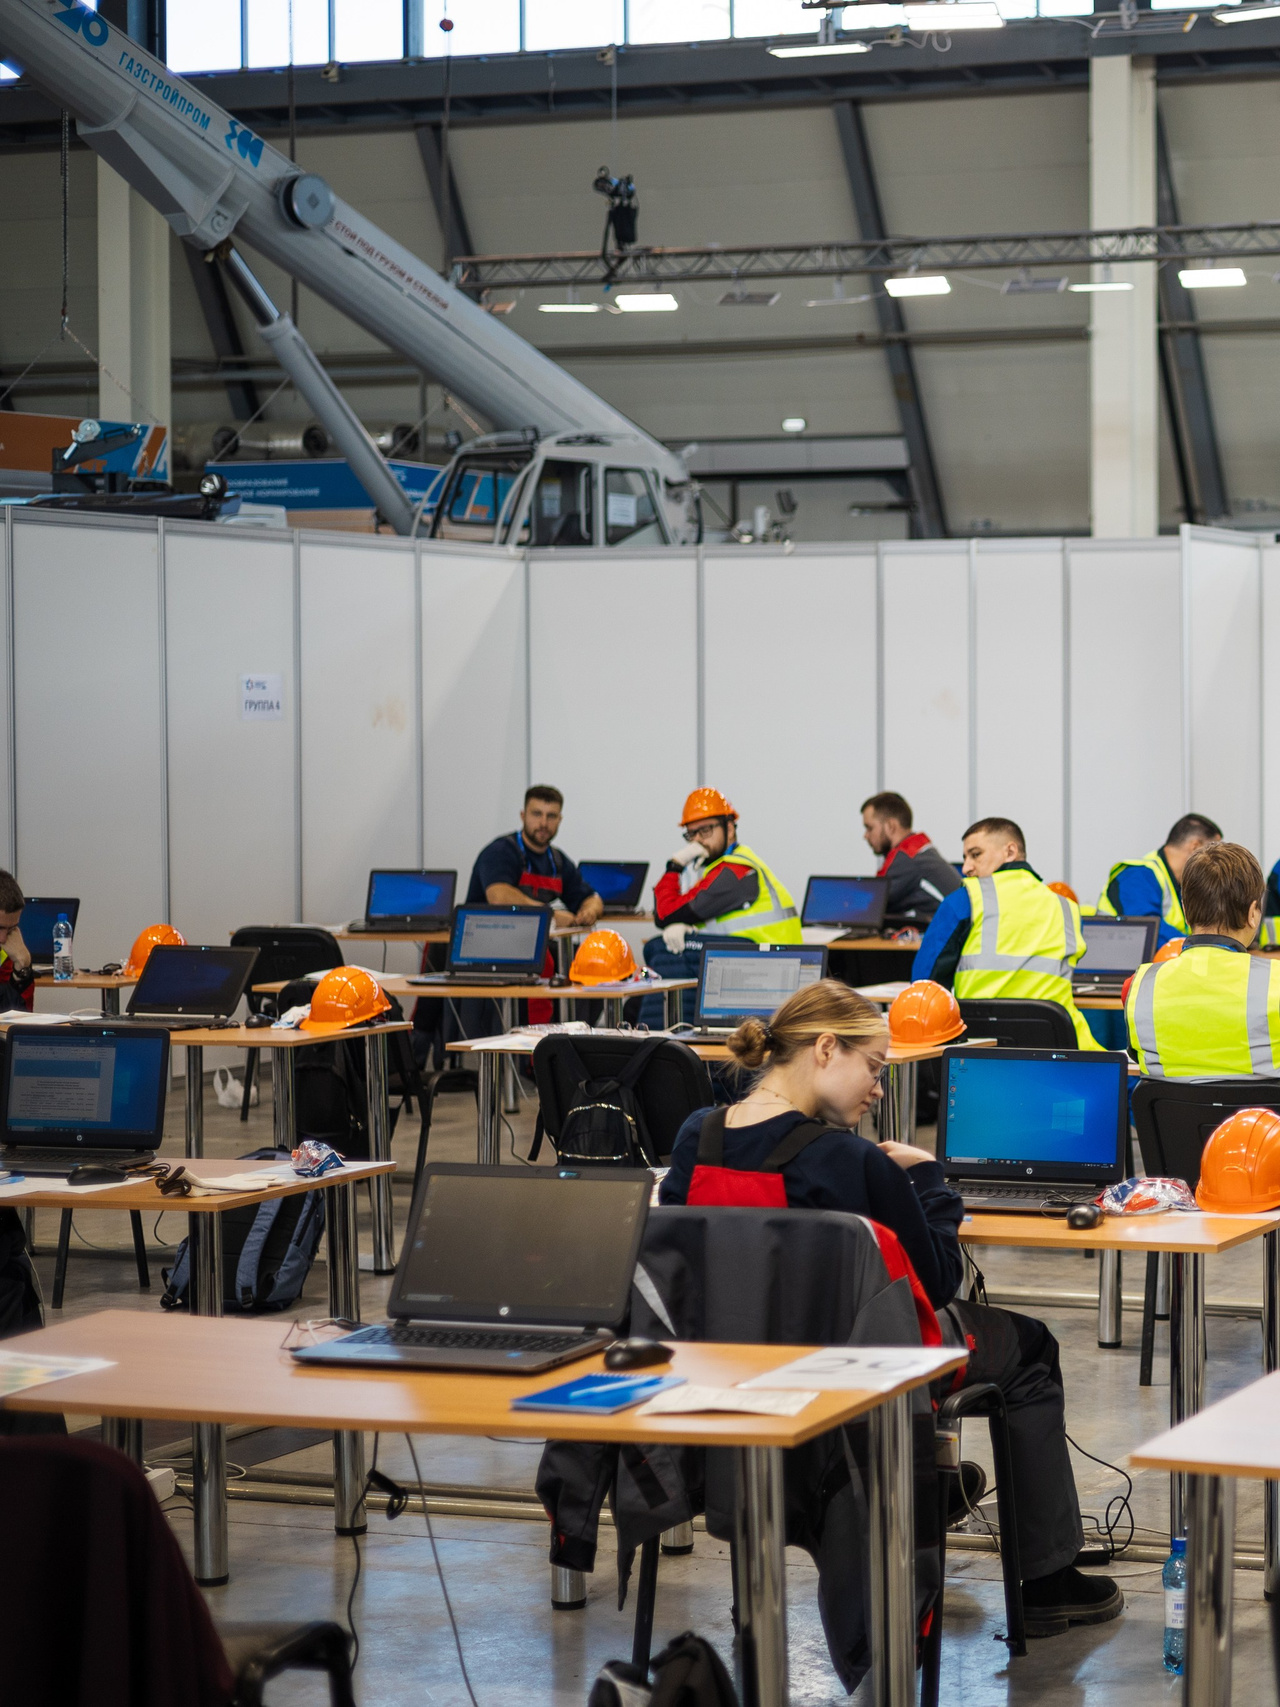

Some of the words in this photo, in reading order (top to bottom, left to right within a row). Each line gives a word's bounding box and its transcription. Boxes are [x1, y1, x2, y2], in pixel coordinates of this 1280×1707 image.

[118, 51, 211, 131] ГАЗСТРОЙПРОМ
[335, 220, 358, 241] СТОЙ
[356, 236, 376, 257] ПОД
[245, 699, 274, 711] ГРУППА
